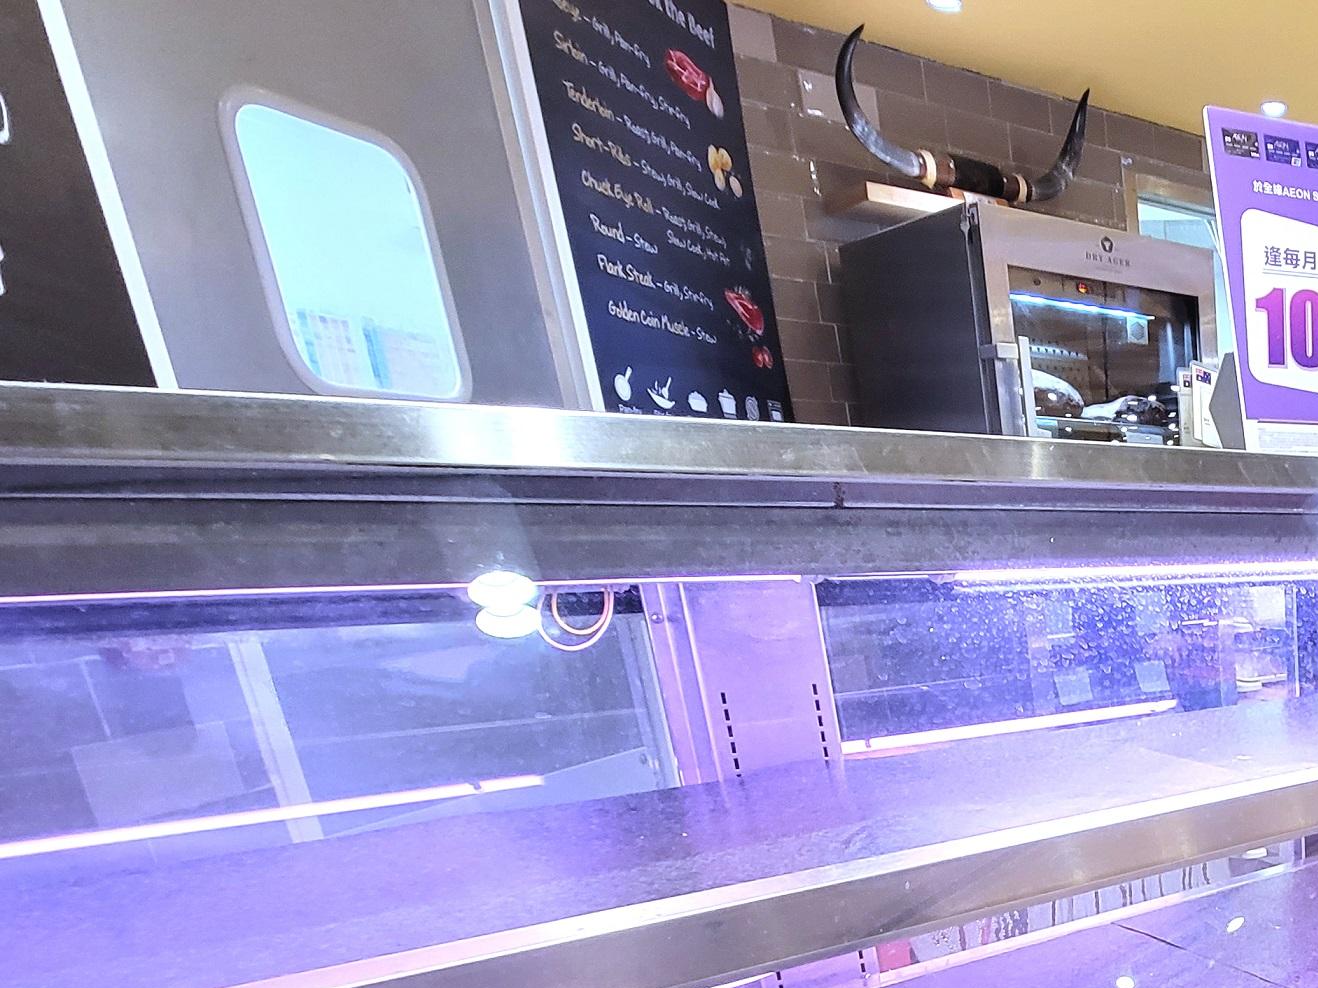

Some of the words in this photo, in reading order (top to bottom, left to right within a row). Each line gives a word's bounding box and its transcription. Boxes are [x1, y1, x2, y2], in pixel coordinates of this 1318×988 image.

[589, 213, 626, 245] Round
[633, 232, 659, 254] Stew
[597, 253, 627, 280] Flank
[625, 263, 657, 289] Steak
[608, 299, 641, 324] Golden
[640, 309, 661, 330] Coin
[661, 314, 691, 338] Muscle
[696, 326, 718, 345] Stew
